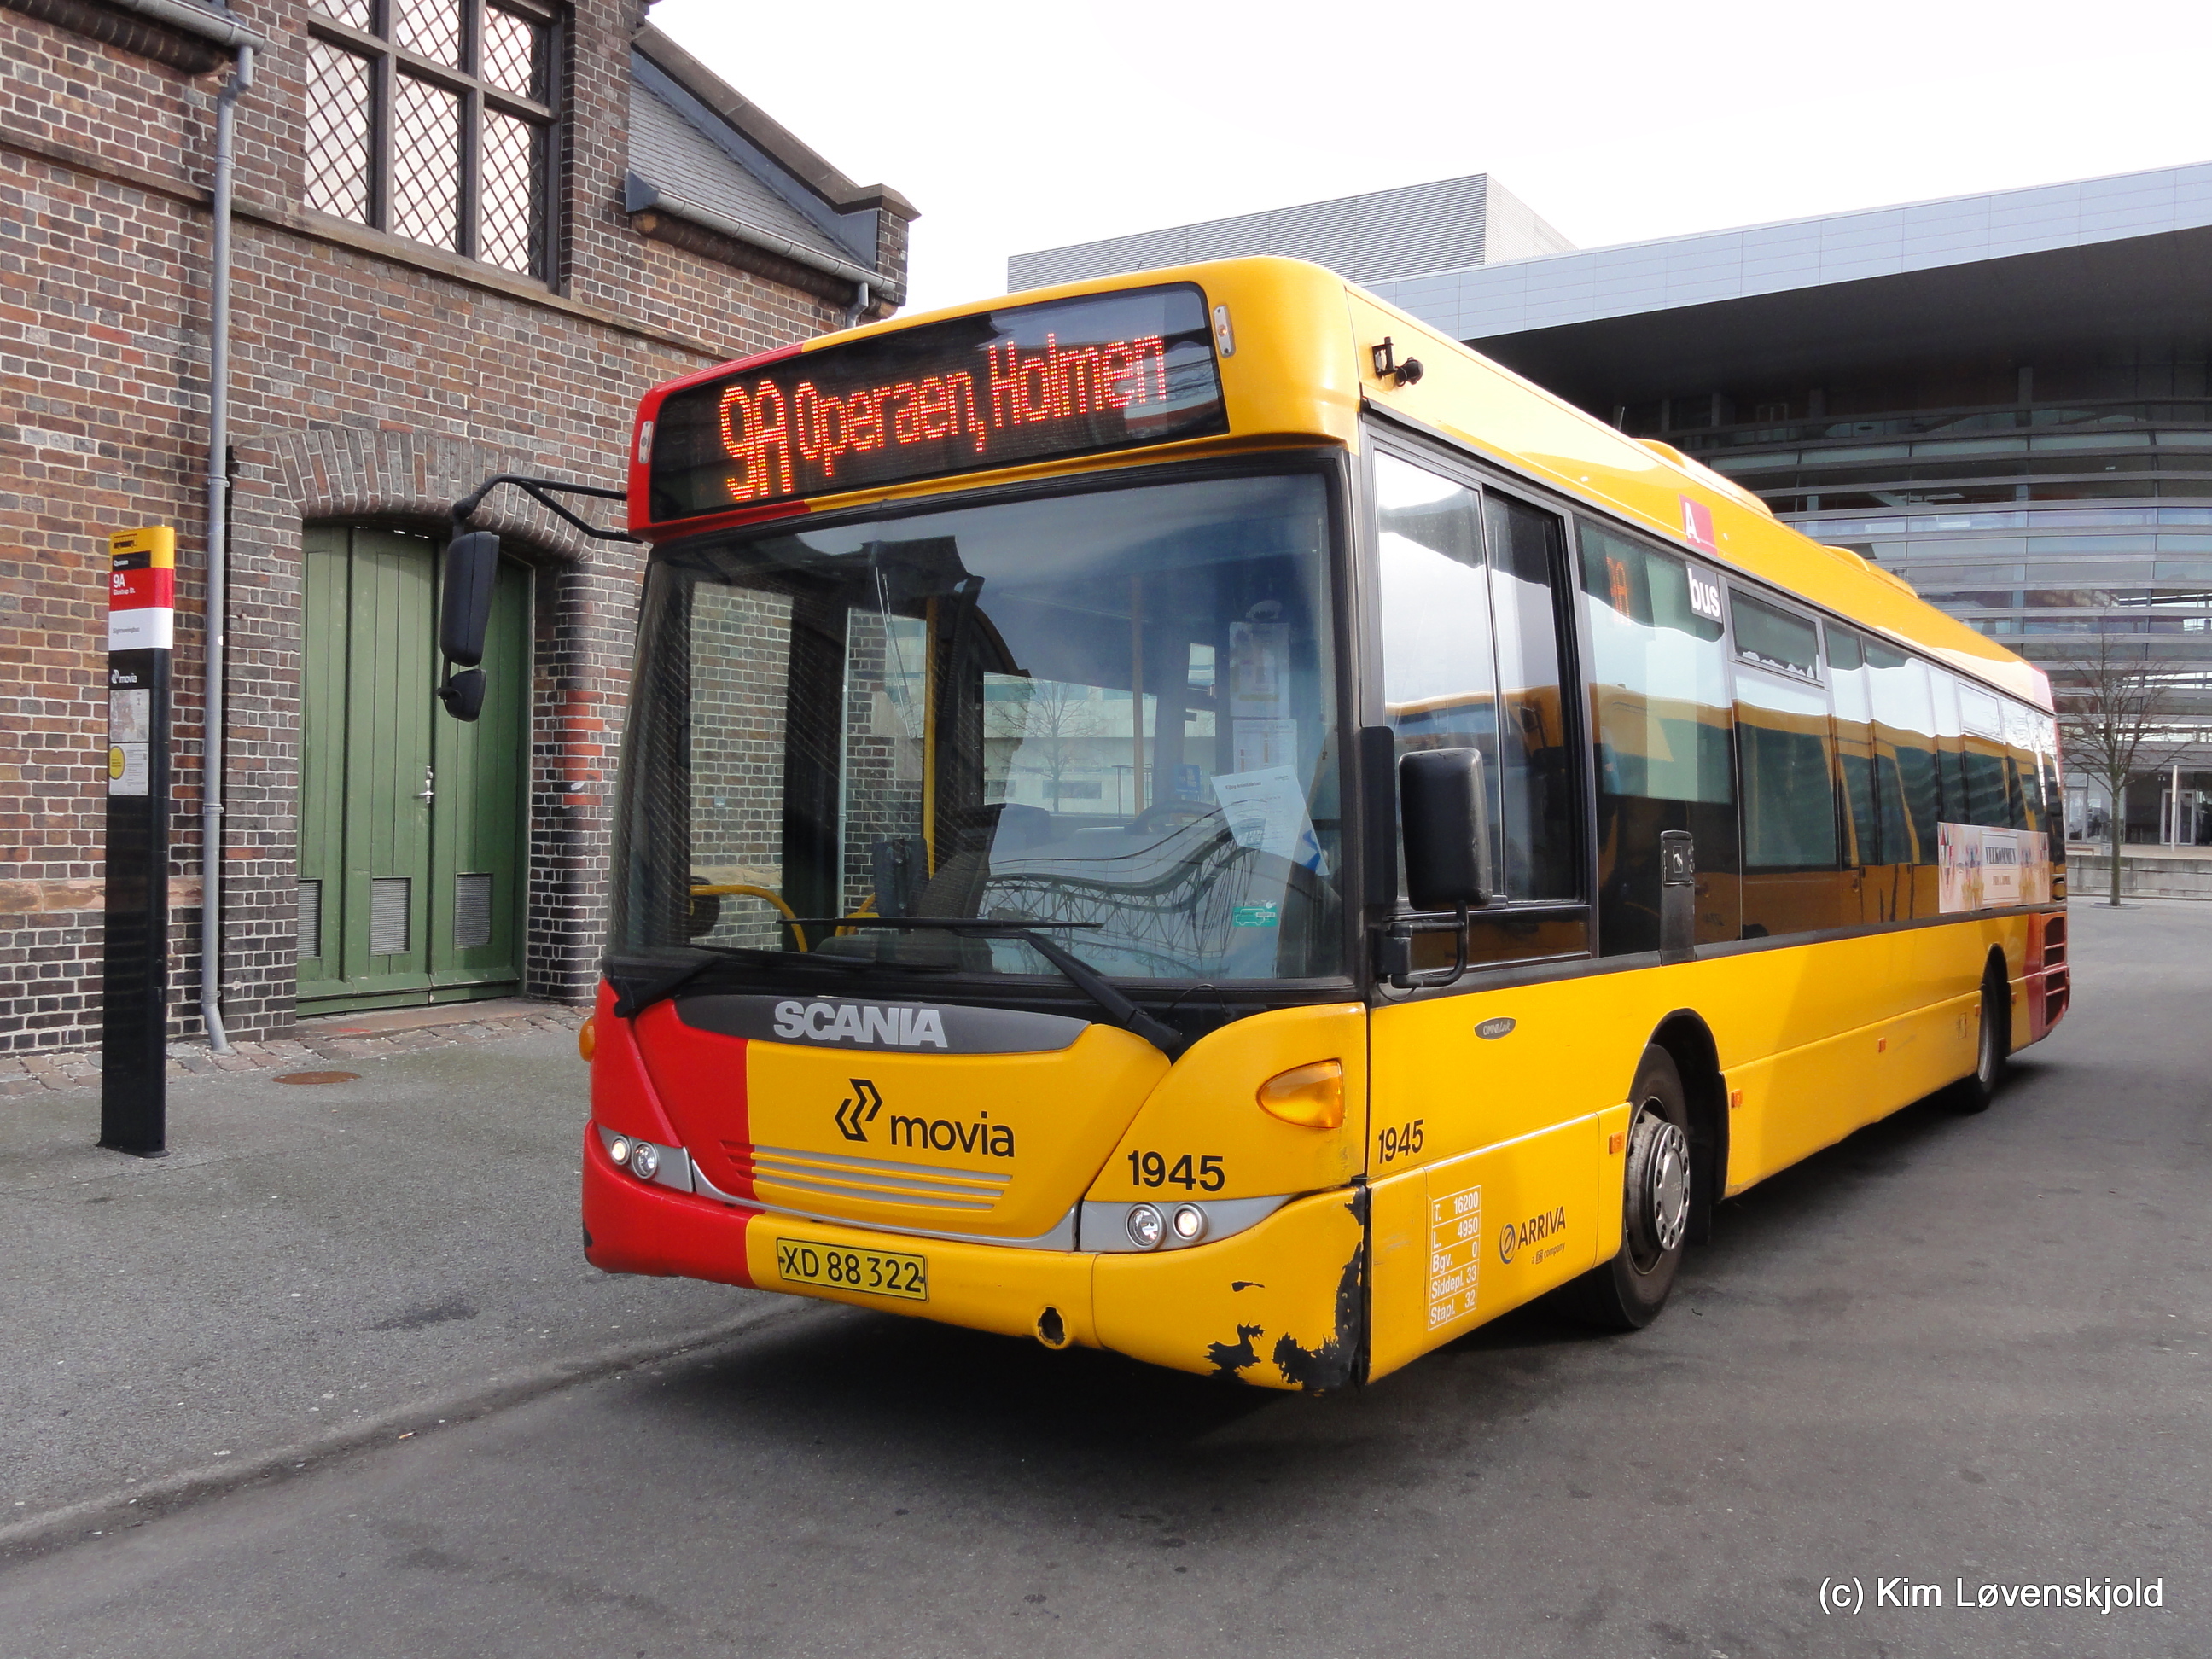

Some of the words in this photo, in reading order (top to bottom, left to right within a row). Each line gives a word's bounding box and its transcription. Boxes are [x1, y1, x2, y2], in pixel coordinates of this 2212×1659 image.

[719, 379, 793, 501] 9A
[795, 370, 986, 478] Operaen,
[988, 332, 1167, 428] Holmen
[1685, 502, 1700, 544] A
[113, 573, 126, 588] 9A
[1687, 568, 1720, 617] bus
[119, 672, 137, 684] movia
[773, 1000, 949, 1049] SCANIA
[890, 1109, 1016, 1159] movia
[1378, 1118, 1424, 1165] 1945
[1127, 1150, 1225, 1193] 1945
[1453, 1191, 1480, 1215] 16200
[1433, 1231, 1441, 1249] L.
[1458, 1216, 1479, 1239] 4950
[1516, 1205, 1567, 1250] ARRIVA
[783, 1245, 820, 1278] XD
[826, 1251, 862, 1285] 88
[866, 1256, 922, 1294] 322
[1432, 1253, 1453, 1274] Bgv.
[1471, 1241, 1478, 1259] 0
[1431, 1270, 1464, 1300] Siddepl.
[1466, 1264, 1477, 1284] 33
[1464, 1289, 1476, 1309] 32
